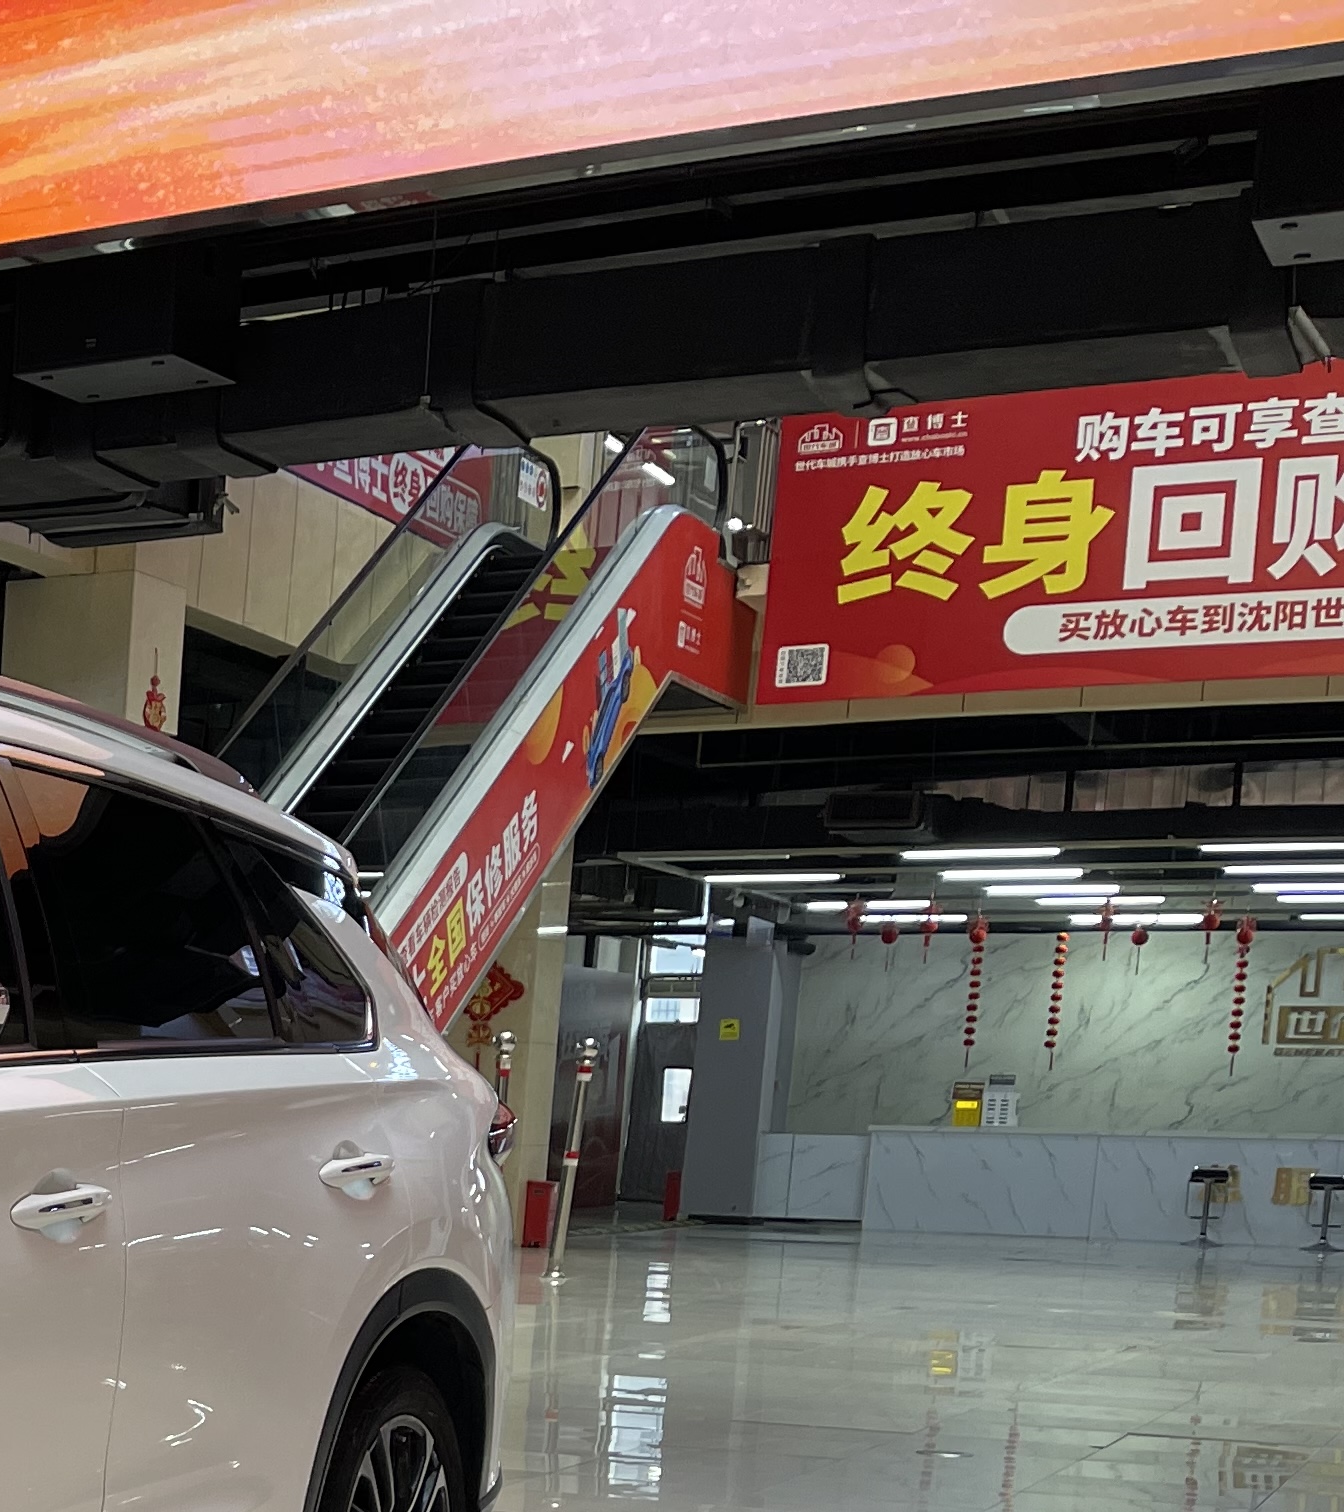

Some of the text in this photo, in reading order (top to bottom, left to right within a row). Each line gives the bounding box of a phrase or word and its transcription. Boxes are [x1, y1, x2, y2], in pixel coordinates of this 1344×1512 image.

[1076, 392, 1344, 462] 购车可享查
[1058, 596, 1344, 642] 买放心车到沈阳世
